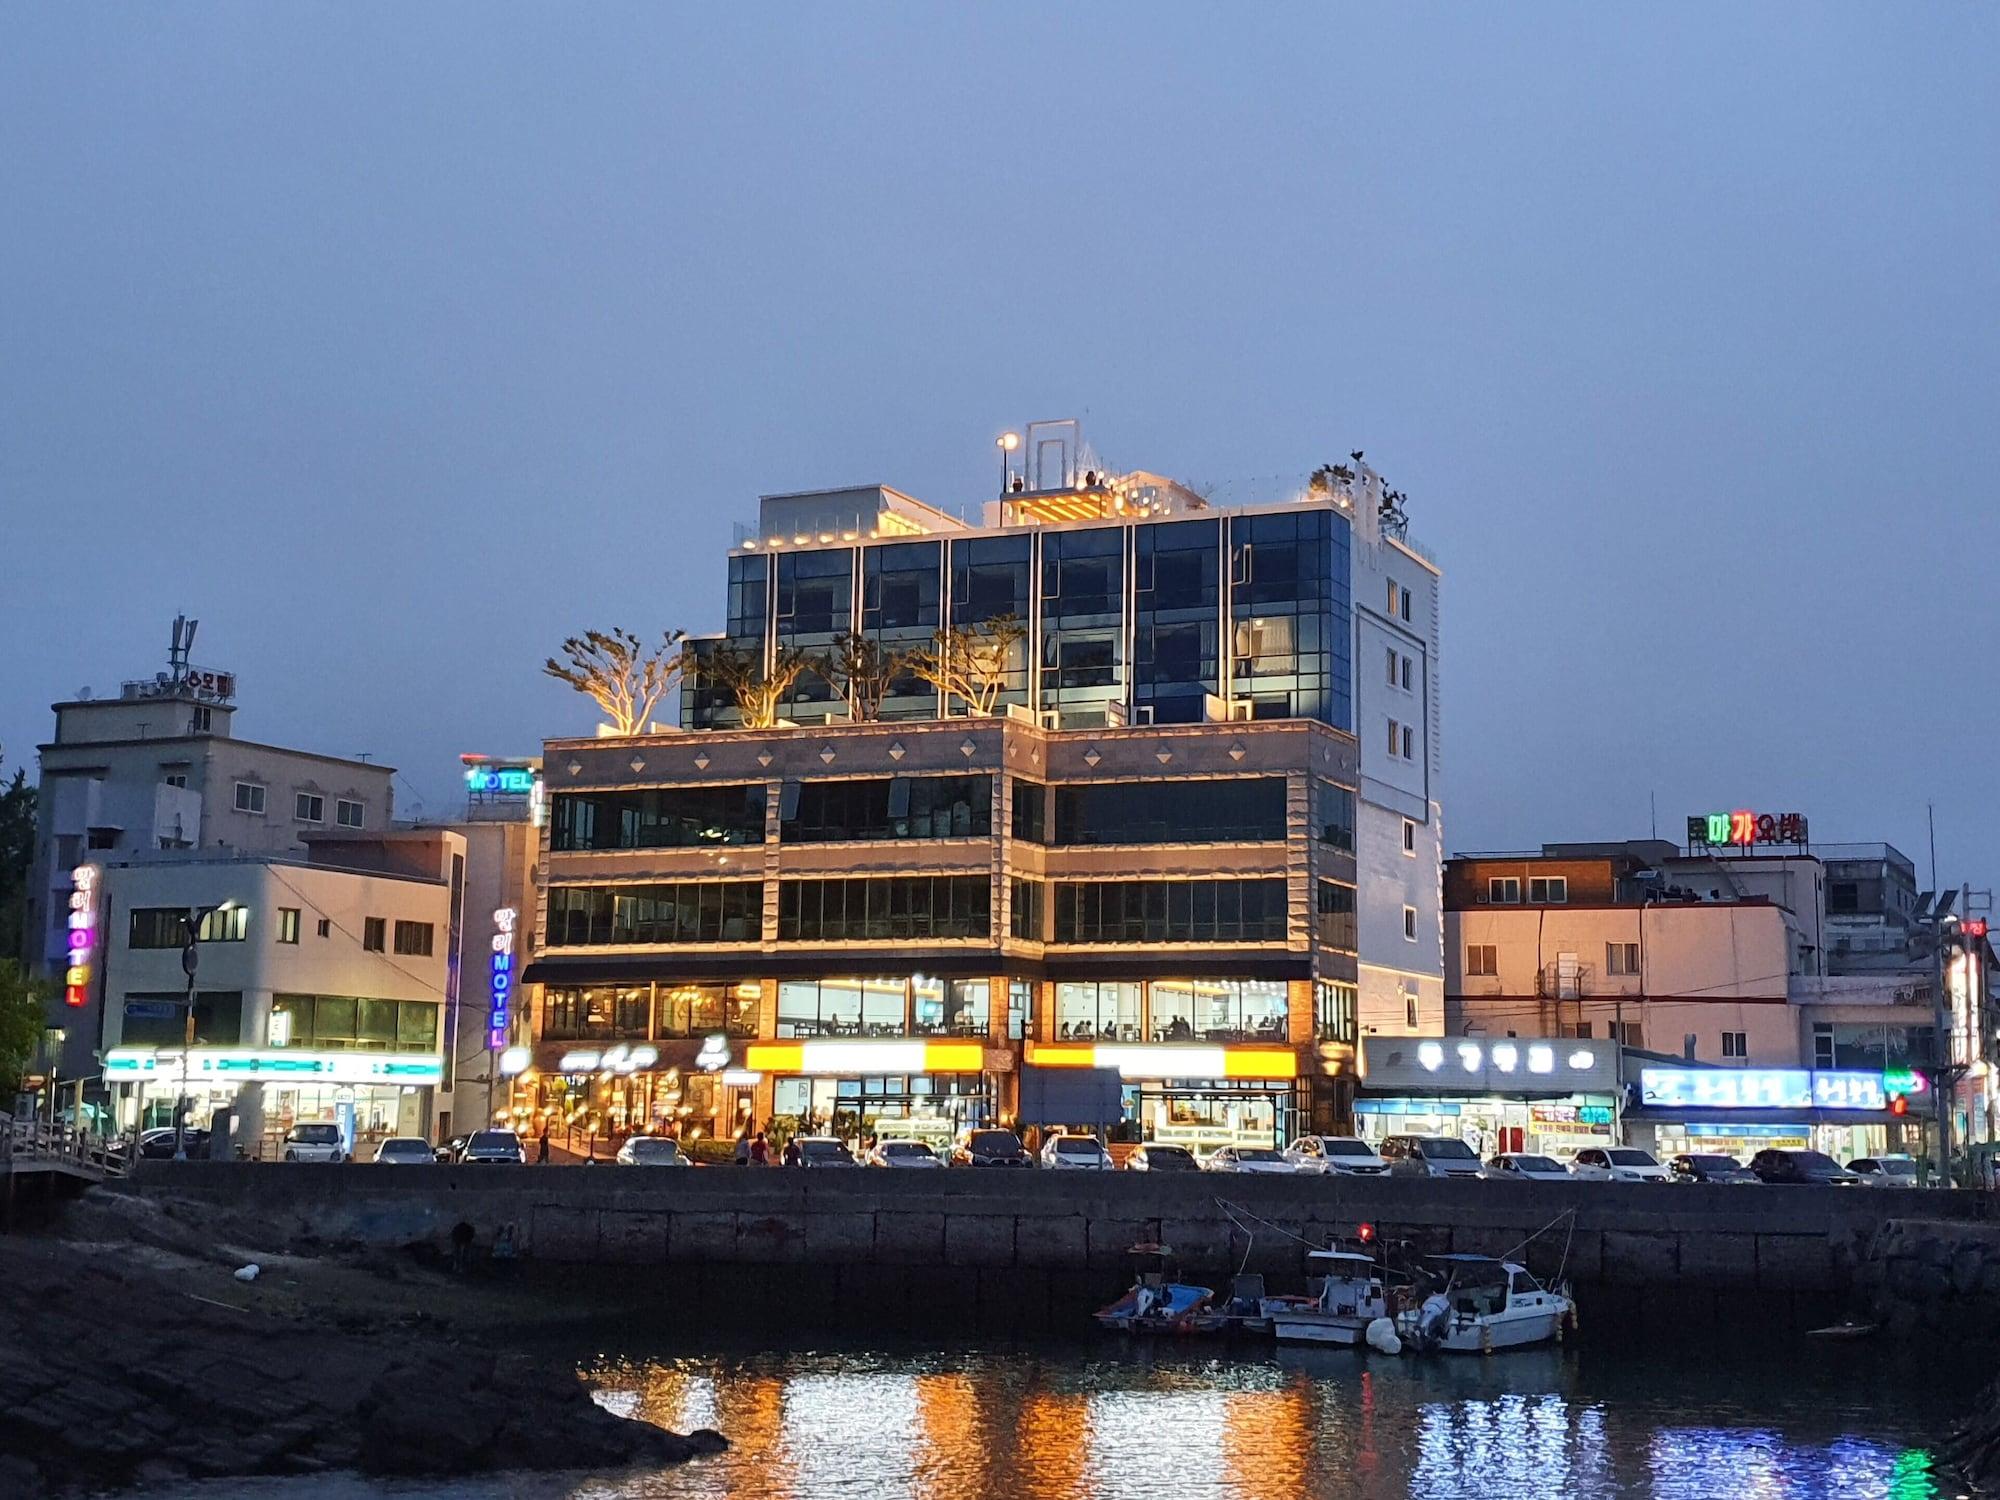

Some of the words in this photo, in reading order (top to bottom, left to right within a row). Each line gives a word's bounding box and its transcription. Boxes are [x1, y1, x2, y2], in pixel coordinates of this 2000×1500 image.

[469, 772, 532, 790] MOTEL
[68, 912, 89, 1004] MOTEL
[491, 954, 510, 1047] MOTEL
